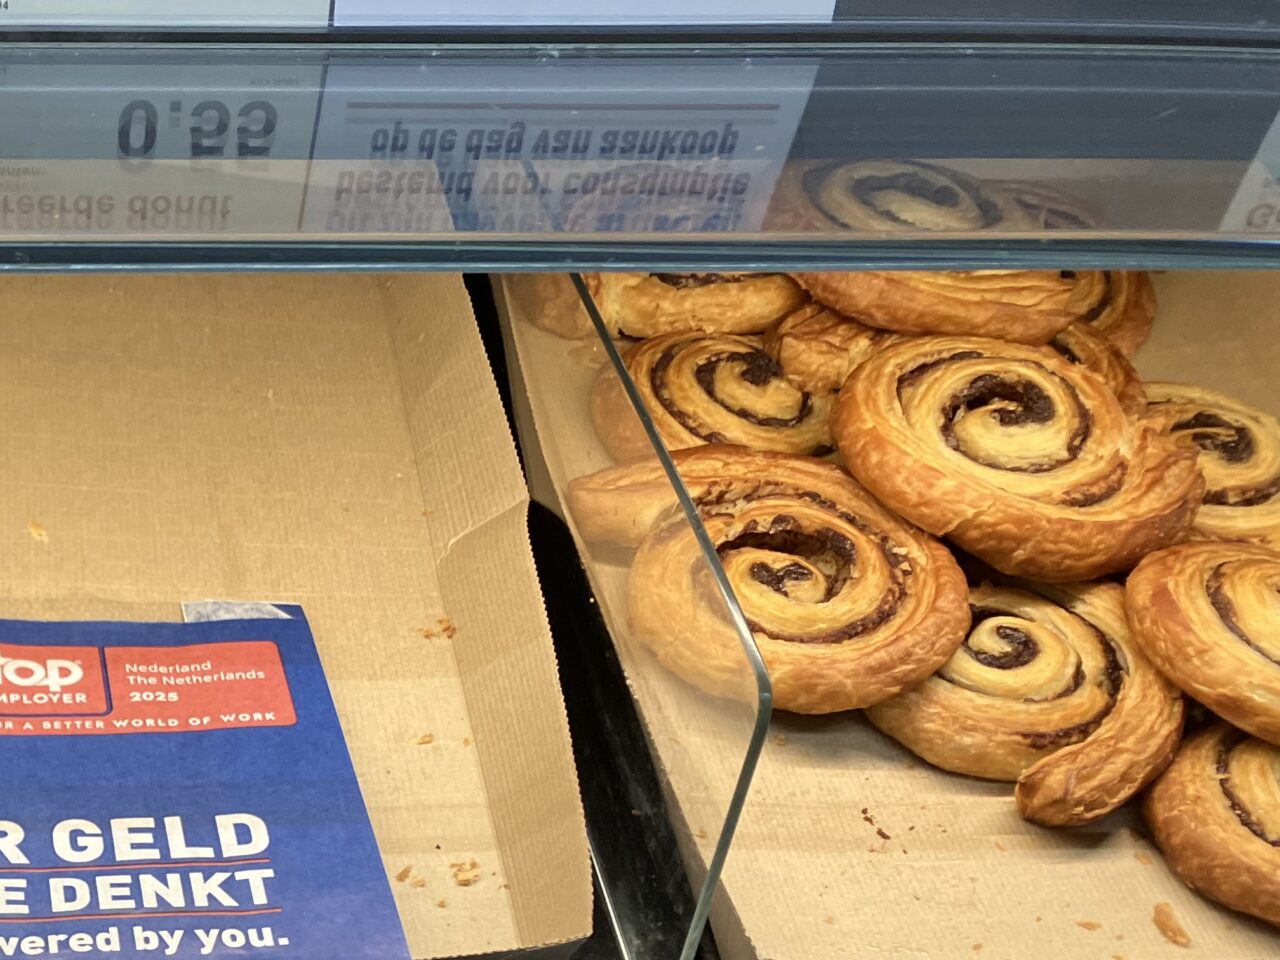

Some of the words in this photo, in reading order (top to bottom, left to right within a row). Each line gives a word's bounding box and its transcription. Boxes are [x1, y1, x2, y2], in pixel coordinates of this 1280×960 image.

[124, 661, 212, 674] Nederland
[126, 675, 158, 686] The
[162, 669, 265, 685] Netherlands
[129, 692, 179, 702] 2025
[22, 721, 34, 730] A
[42, 720, 104, 729] BETTER
[112, 718, 179, 728] WORLD
[188, 716, 211, 725] OF
[219, 711, 277, 722] WORK
[52, 813, 270, 864] GELD
[48, 868, 275, 913] DENKT
[132, 926, 184, 954] by
[193, 927, 289, 954] you.
